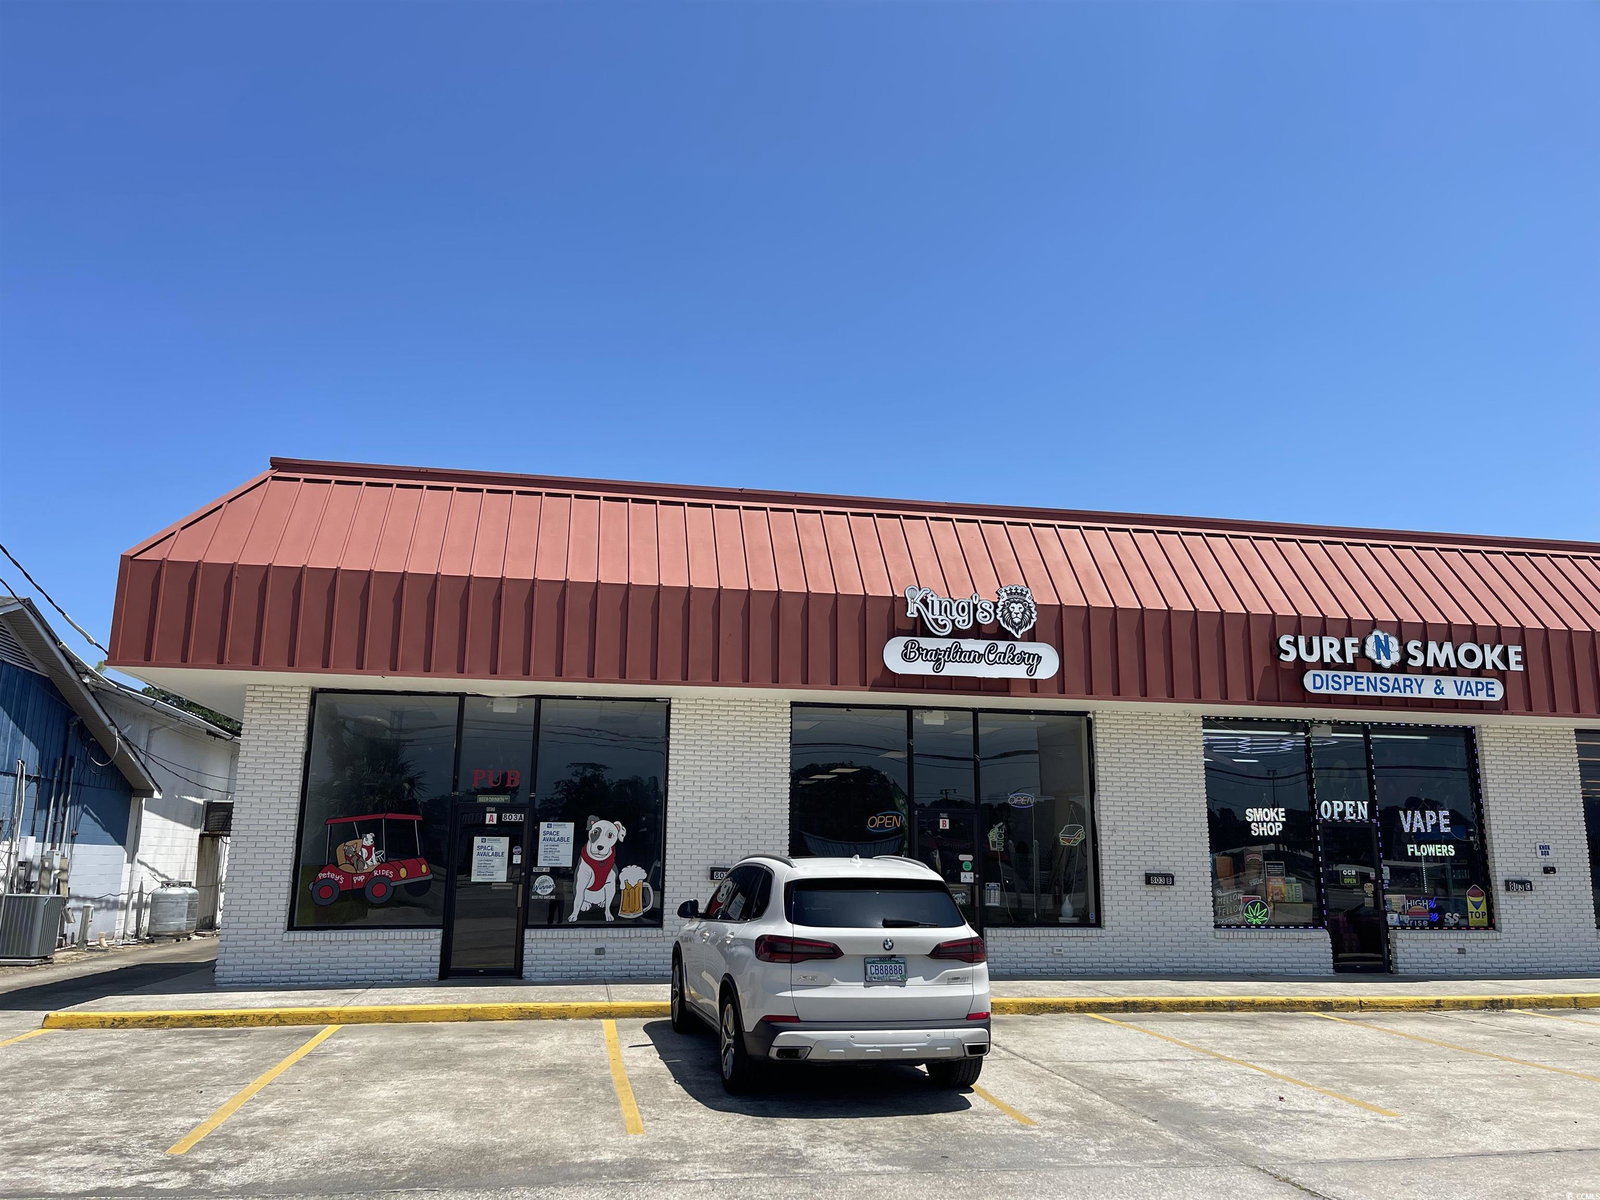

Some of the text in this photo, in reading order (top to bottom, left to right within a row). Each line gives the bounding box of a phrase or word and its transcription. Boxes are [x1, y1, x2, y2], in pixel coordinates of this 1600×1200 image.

[905, 585, 994, 636] King's
[901, 639, 1042, 676] Brazilian Cakery
[1279, 634, 1524, 671] SURF N SMOKE
[1312, 673, 1497, 698] DISPENSARY & VAPE
[472, 768, 521, 788] PUB
[1007, 796, 1035, 805] OPEN
[1245, 807, 1287, 822] SMOKE
[1320, 800, 1369, 820] OPEN
[488, 814, 495, 823] A
[502, 813, 524, 822] 803A
[867, 815, 901, 829] OPEN
[1399, 810, 1451, 833] VAPE
[1250, 822, 1283, 836] SHOP
[1407, 844, 1455, 857] FLOWERS
[373, 869, 394, 878] RIDES
[714, 871, 727, 880] 80
[1406, 899, 1429, 910] HIGH
[1469, 911, 1487, 919] TOP
